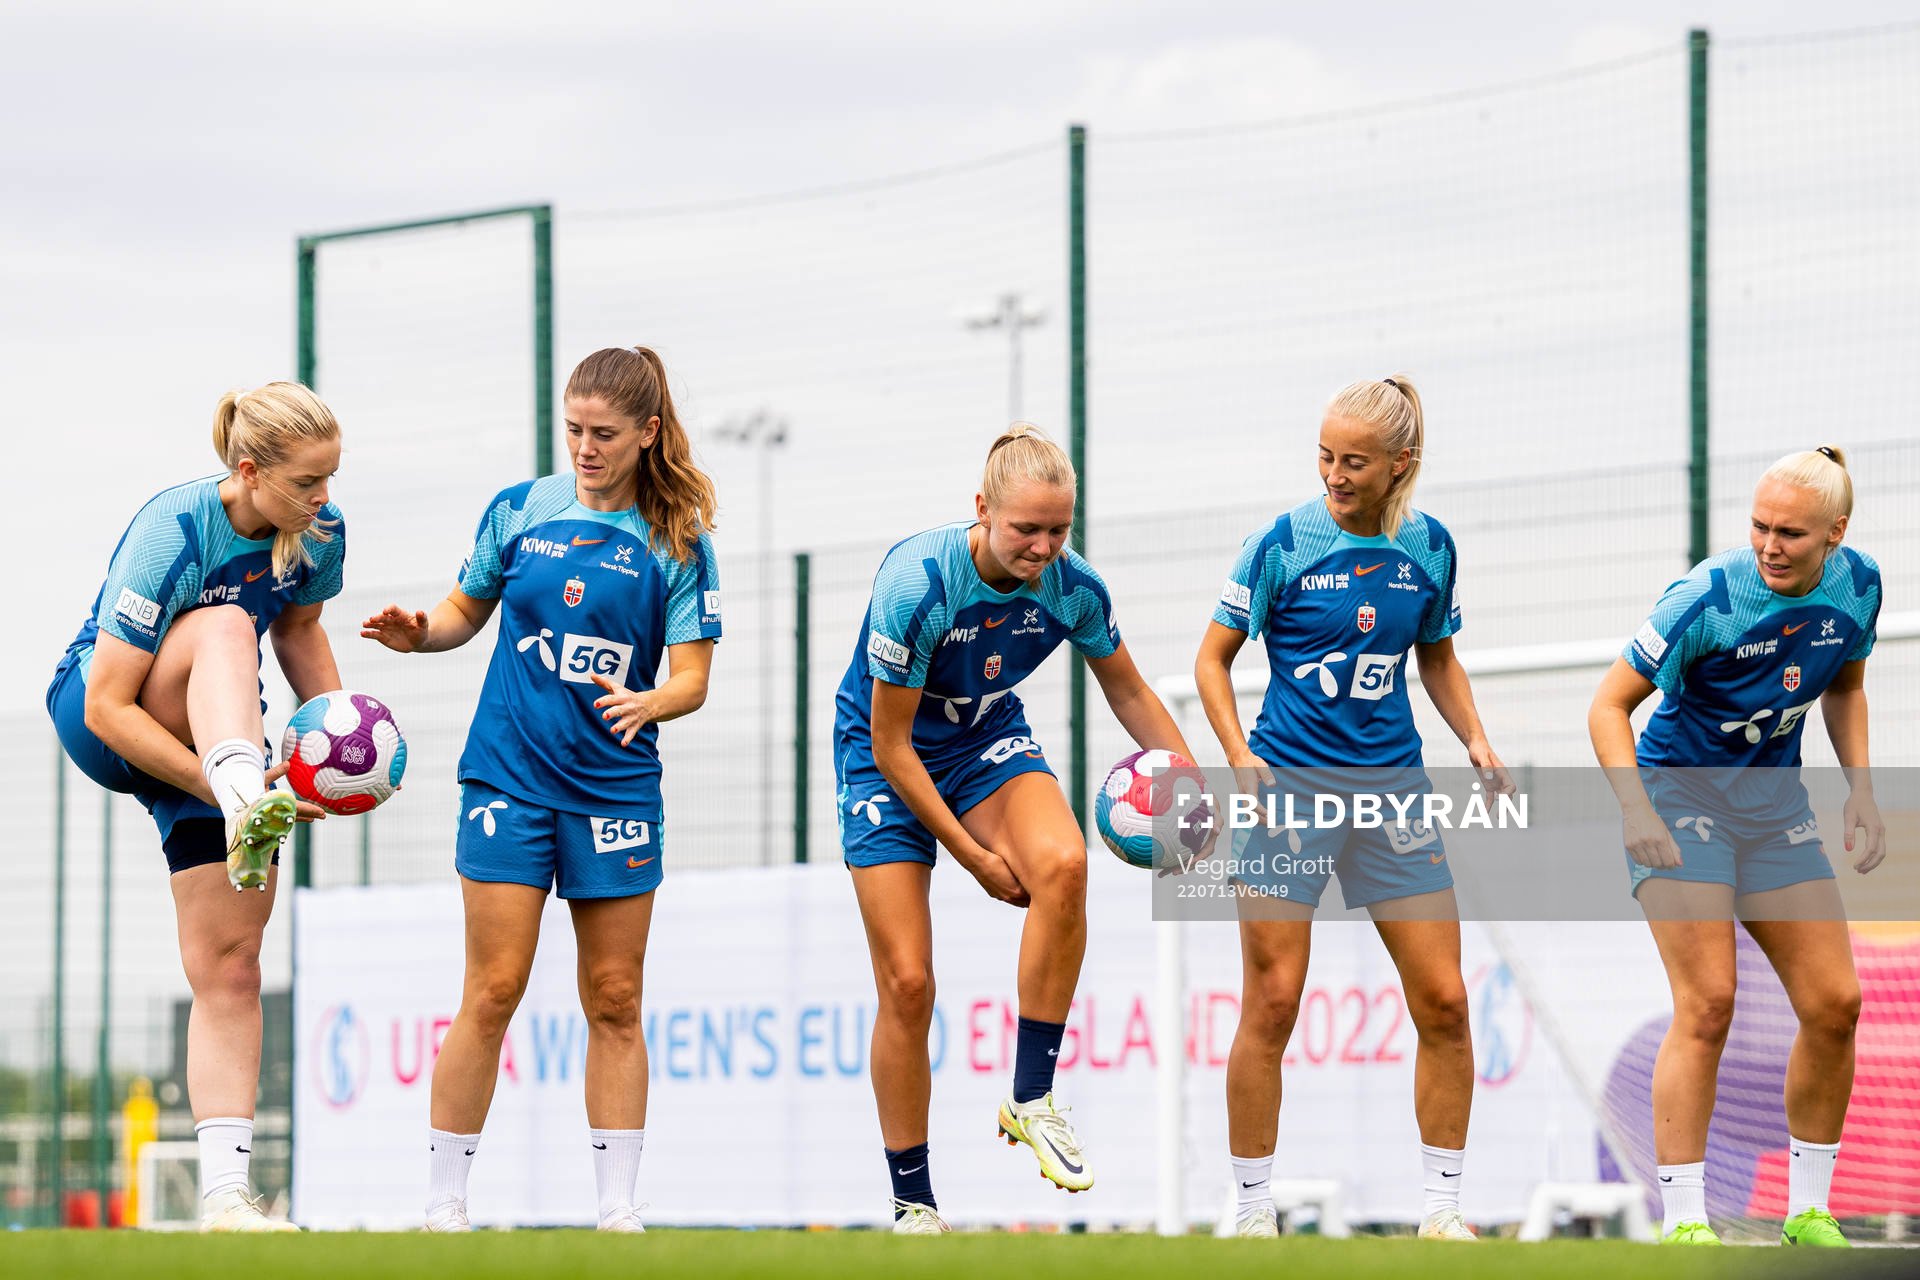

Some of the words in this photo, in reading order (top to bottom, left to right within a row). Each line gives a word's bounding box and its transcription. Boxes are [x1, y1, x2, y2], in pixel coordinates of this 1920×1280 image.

[520, 536, 553, 557] KIWI
[600, 561, 618, 572] Norsk
[617, 565, 639, 578] Tipping
[1301, 573, 1334, 591] KIWI
[1388, 581, 1403, 590] Norsk
[1402, 583, 1419, 592] Tipping
[120, 593, 154, 620] DNB
[872, 637, 904, 661] DNB
[1736, 641, 1764, 660] KIWI
[568, 645, 622, 676] 5G
[600, 819, 642, 845] 5G
[797, 1006, 948, 1077] EUO
[1283, 986, 1404, 1065] 022
